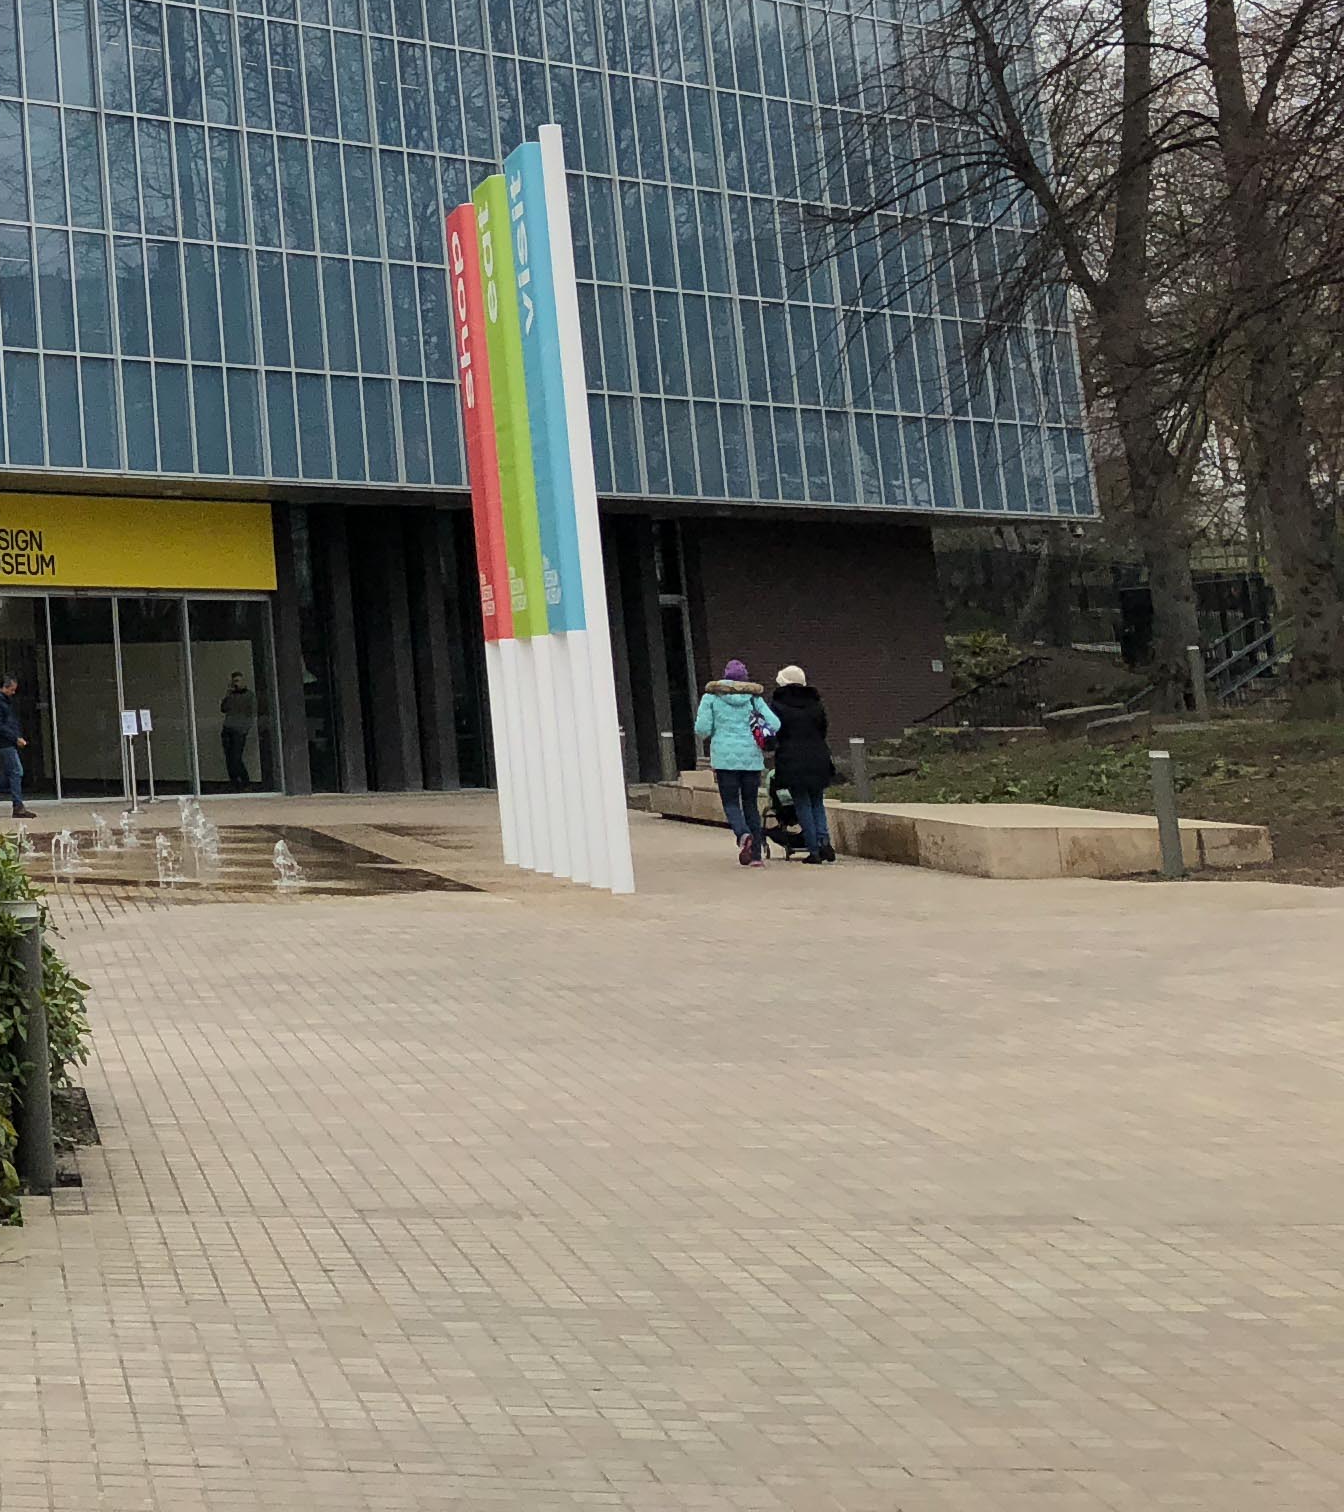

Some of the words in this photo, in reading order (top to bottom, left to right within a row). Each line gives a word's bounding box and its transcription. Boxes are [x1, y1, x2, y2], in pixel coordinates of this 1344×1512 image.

[452, 231, 475, 409] shop
[478, 201, 498, 324] eat
[510, 170, 534, 336] visit
